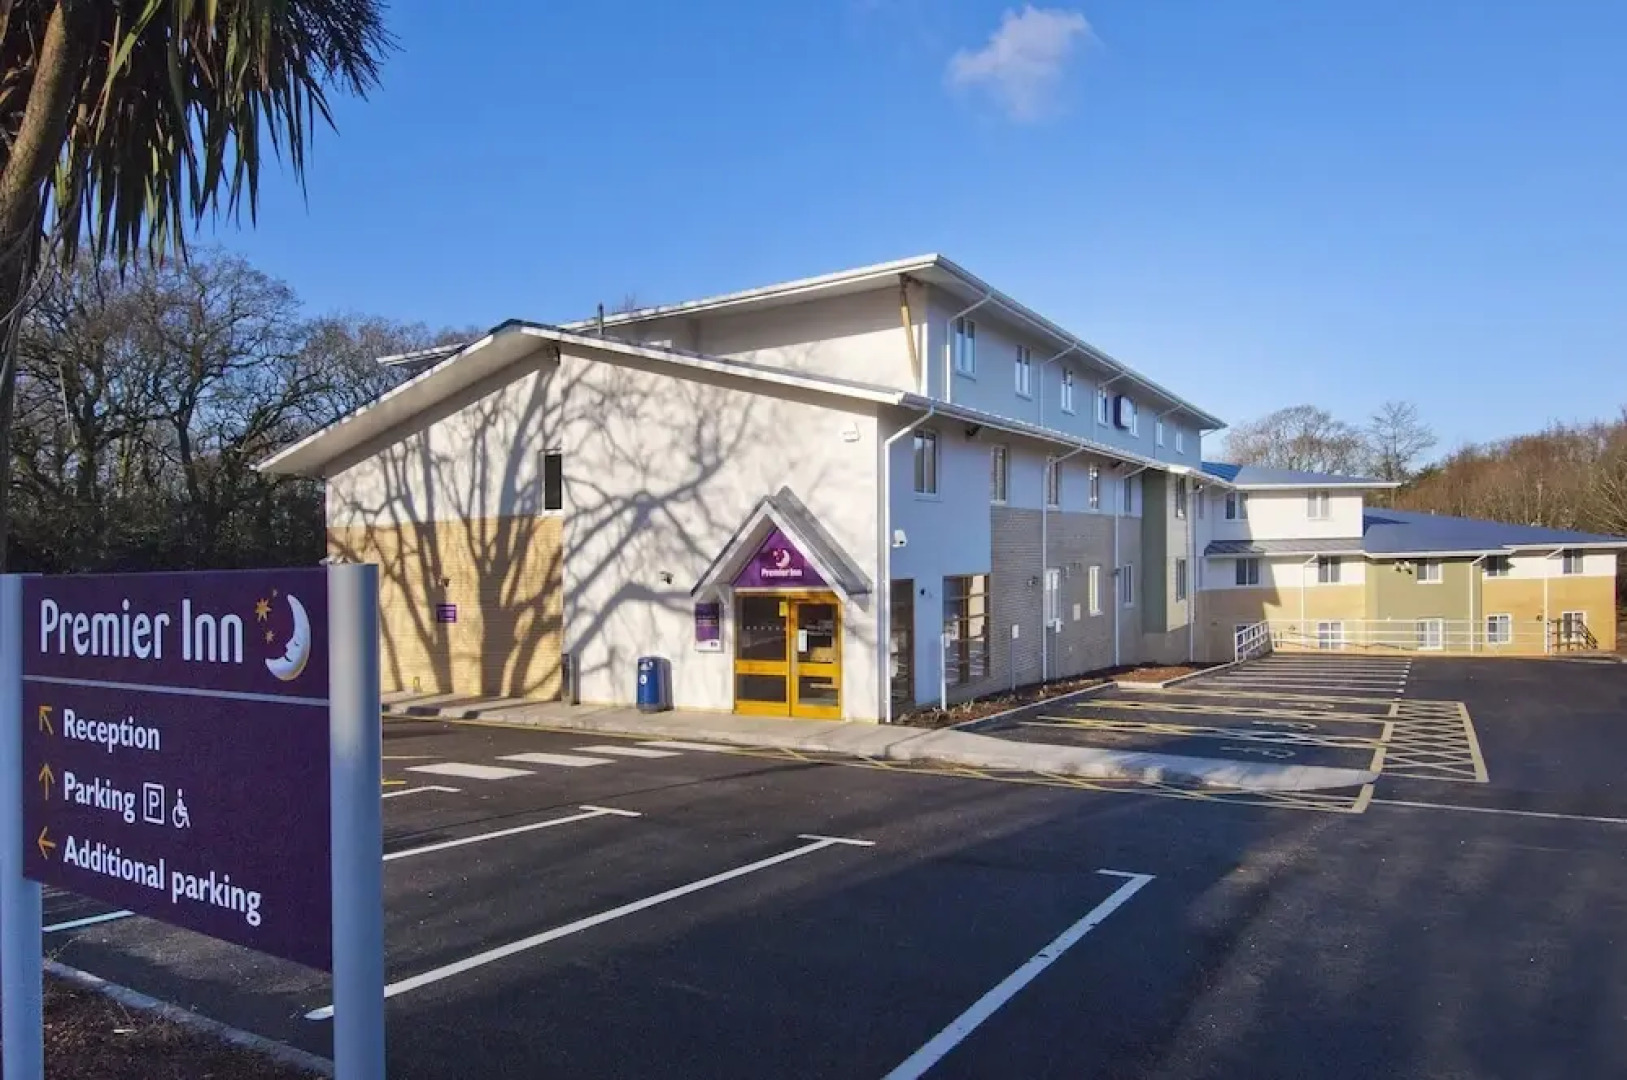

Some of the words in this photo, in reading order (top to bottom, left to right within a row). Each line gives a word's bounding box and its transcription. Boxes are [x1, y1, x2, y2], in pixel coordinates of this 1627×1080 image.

[41, 598, 170, 659] Premier
[181, 599, 244, 663] Inn
[63, 708, 160, 753] Reception
[64, 771, 136, 823] Parking
[63, 835, 165, 890] Additional
[171, 871, 262, 927] parking
